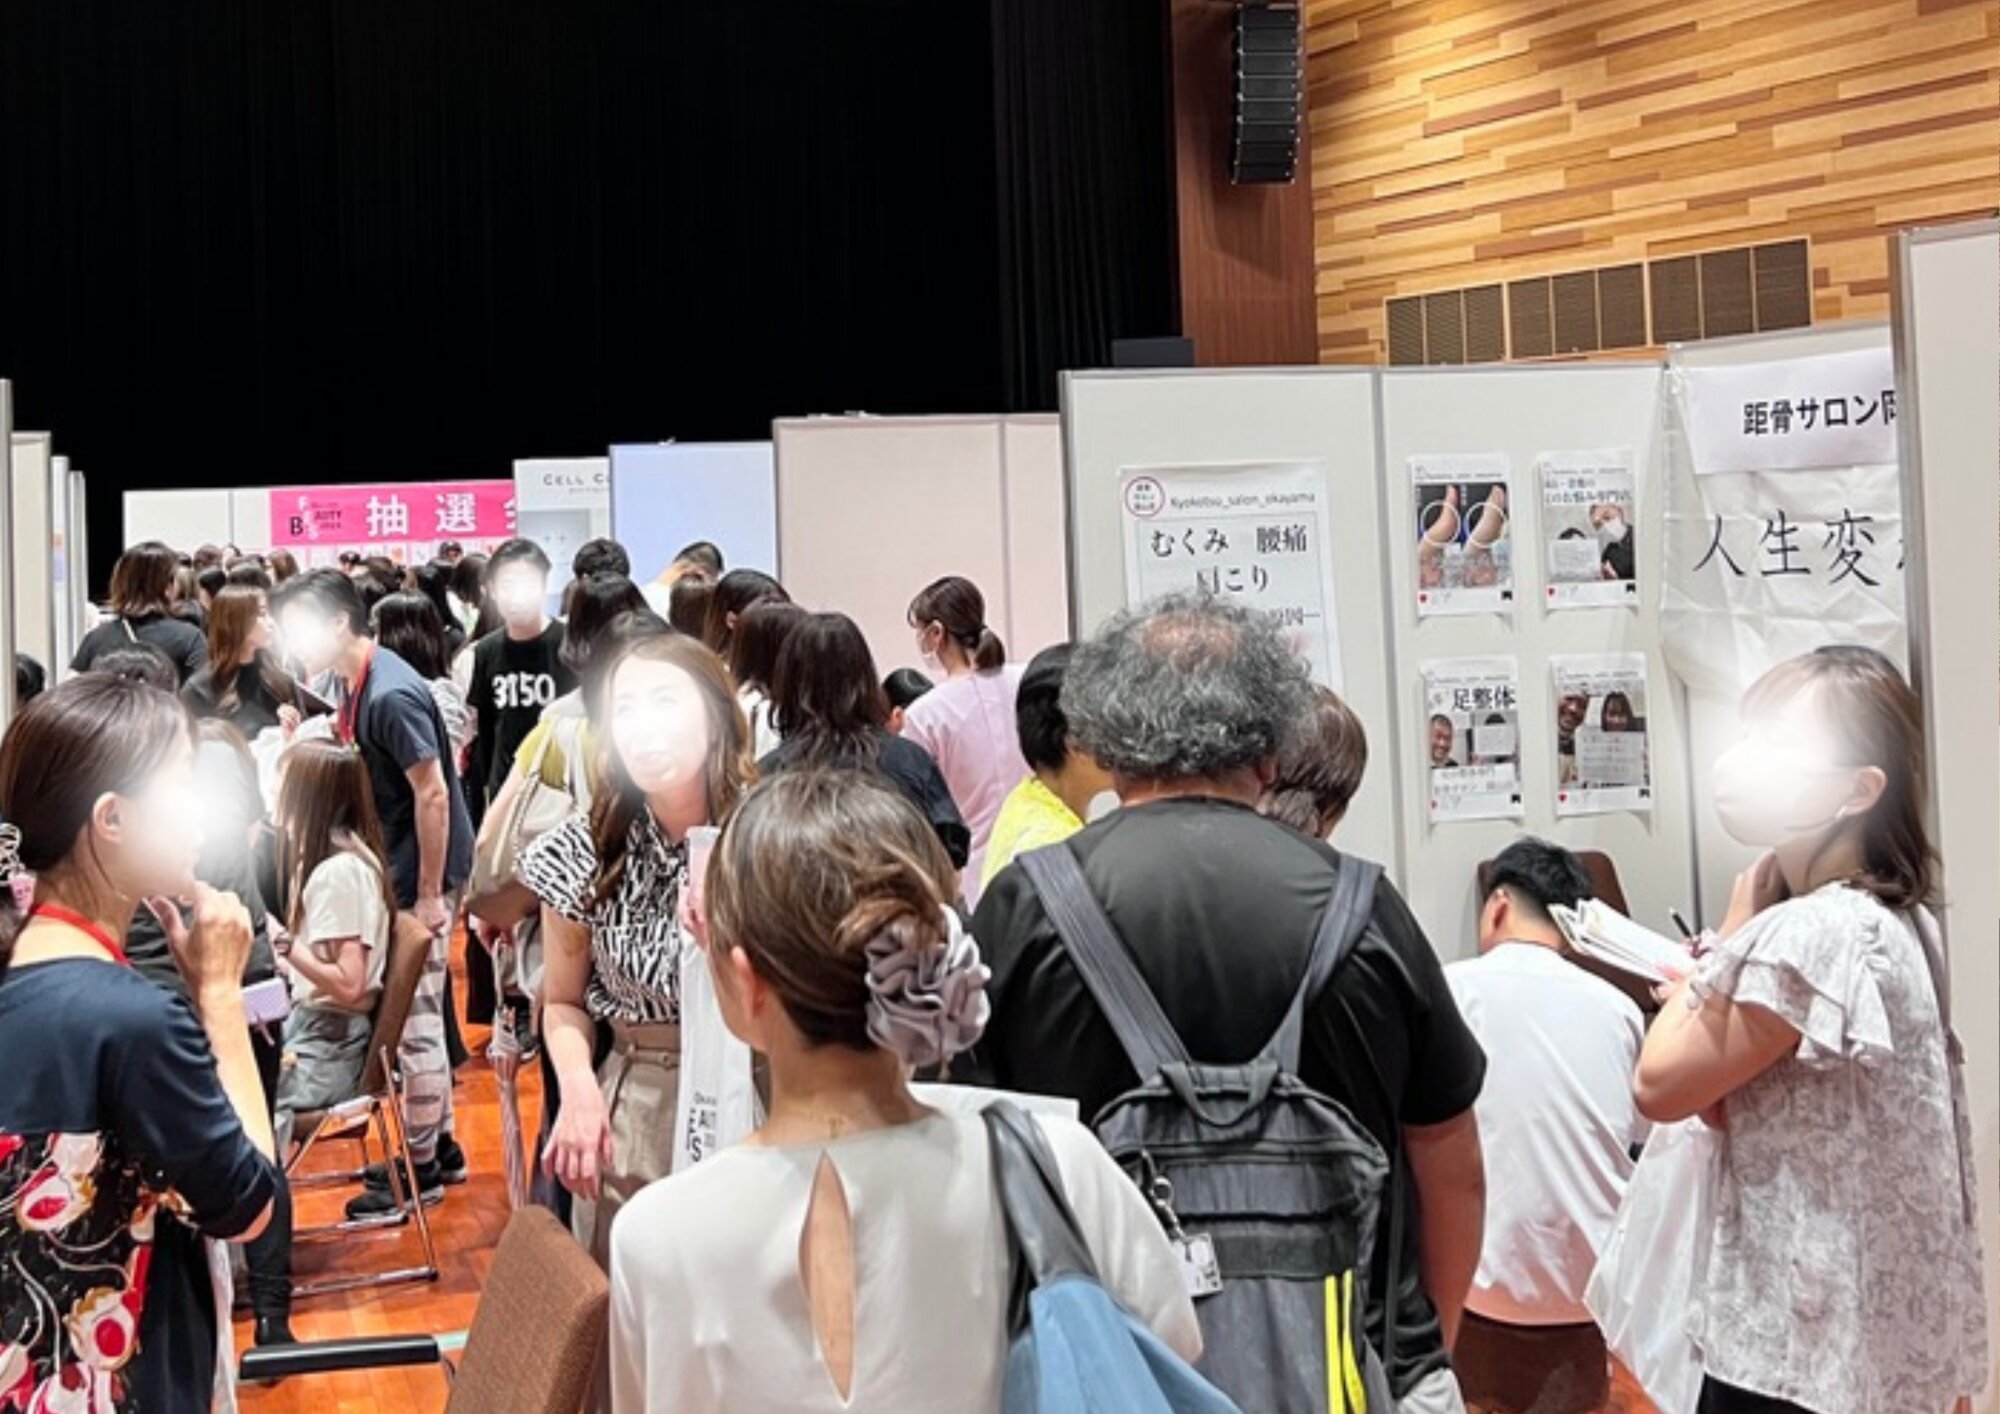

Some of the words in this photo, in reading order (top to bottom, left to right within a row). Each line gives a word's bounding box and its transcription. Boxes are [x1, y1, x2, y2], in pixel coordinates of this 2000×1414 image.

[593, 472, 610, 484] C
[366, 493, 516, 537] 抽選
[1151, 528, 1229, 558] むくみ
[1256, 524, 1307, 553] 腰痛
[1692, 508, 1905, 586] 人生変
[491, 671, 556, 709] 3150
